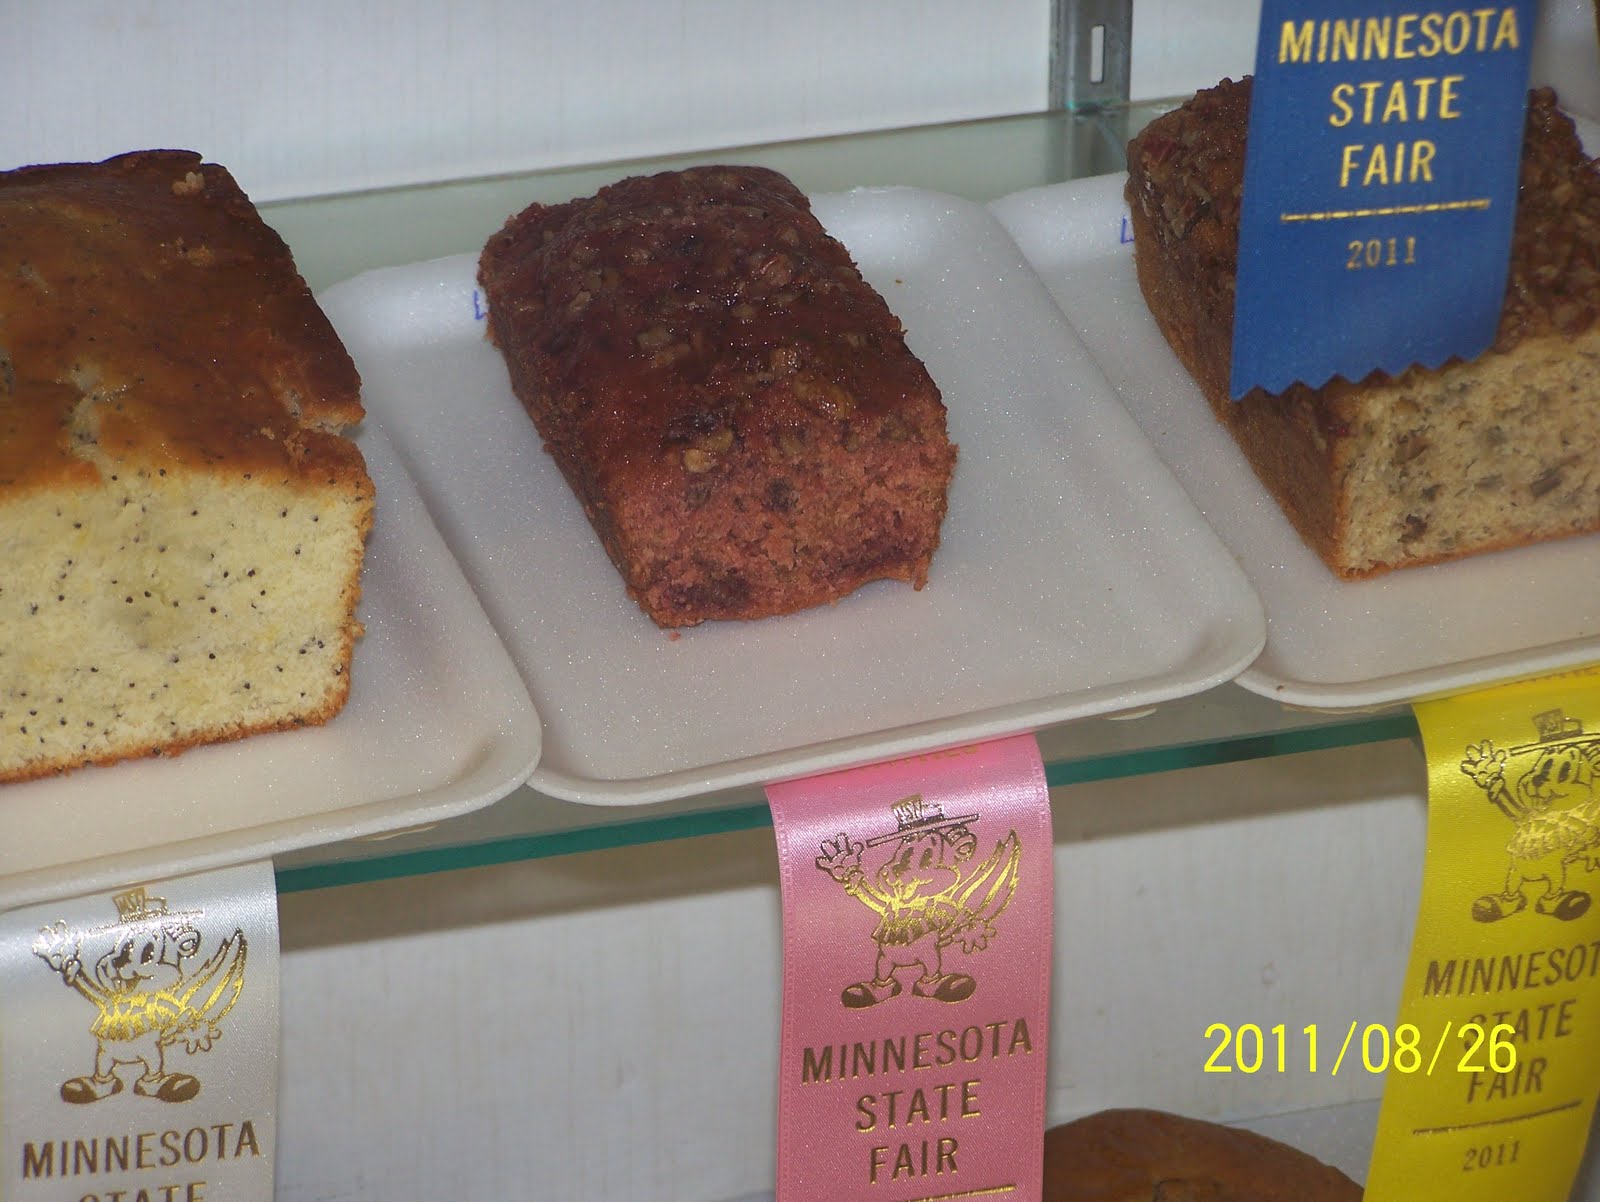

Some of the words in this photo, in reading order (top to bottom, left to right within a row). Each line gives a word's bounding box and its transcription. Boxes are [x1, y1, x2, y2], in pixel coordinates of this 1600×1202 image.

[1278, 7, 1520, 64] MINNESOTA
[1328, 75, 1465, 128] STATE
[1338, 139, 1437, 188] FAIR
[1346, 236, 1417, 270] 2011
[801, 1017, 1034, 1086] MINNESOTA
[854, 1078, 982, 1134] STATE
[22, 1119, 261, 1180] MINNESOTA
[868, 1137, 959, 1185] FAIR
[1462, 1140, 1521, 1173] 2011
